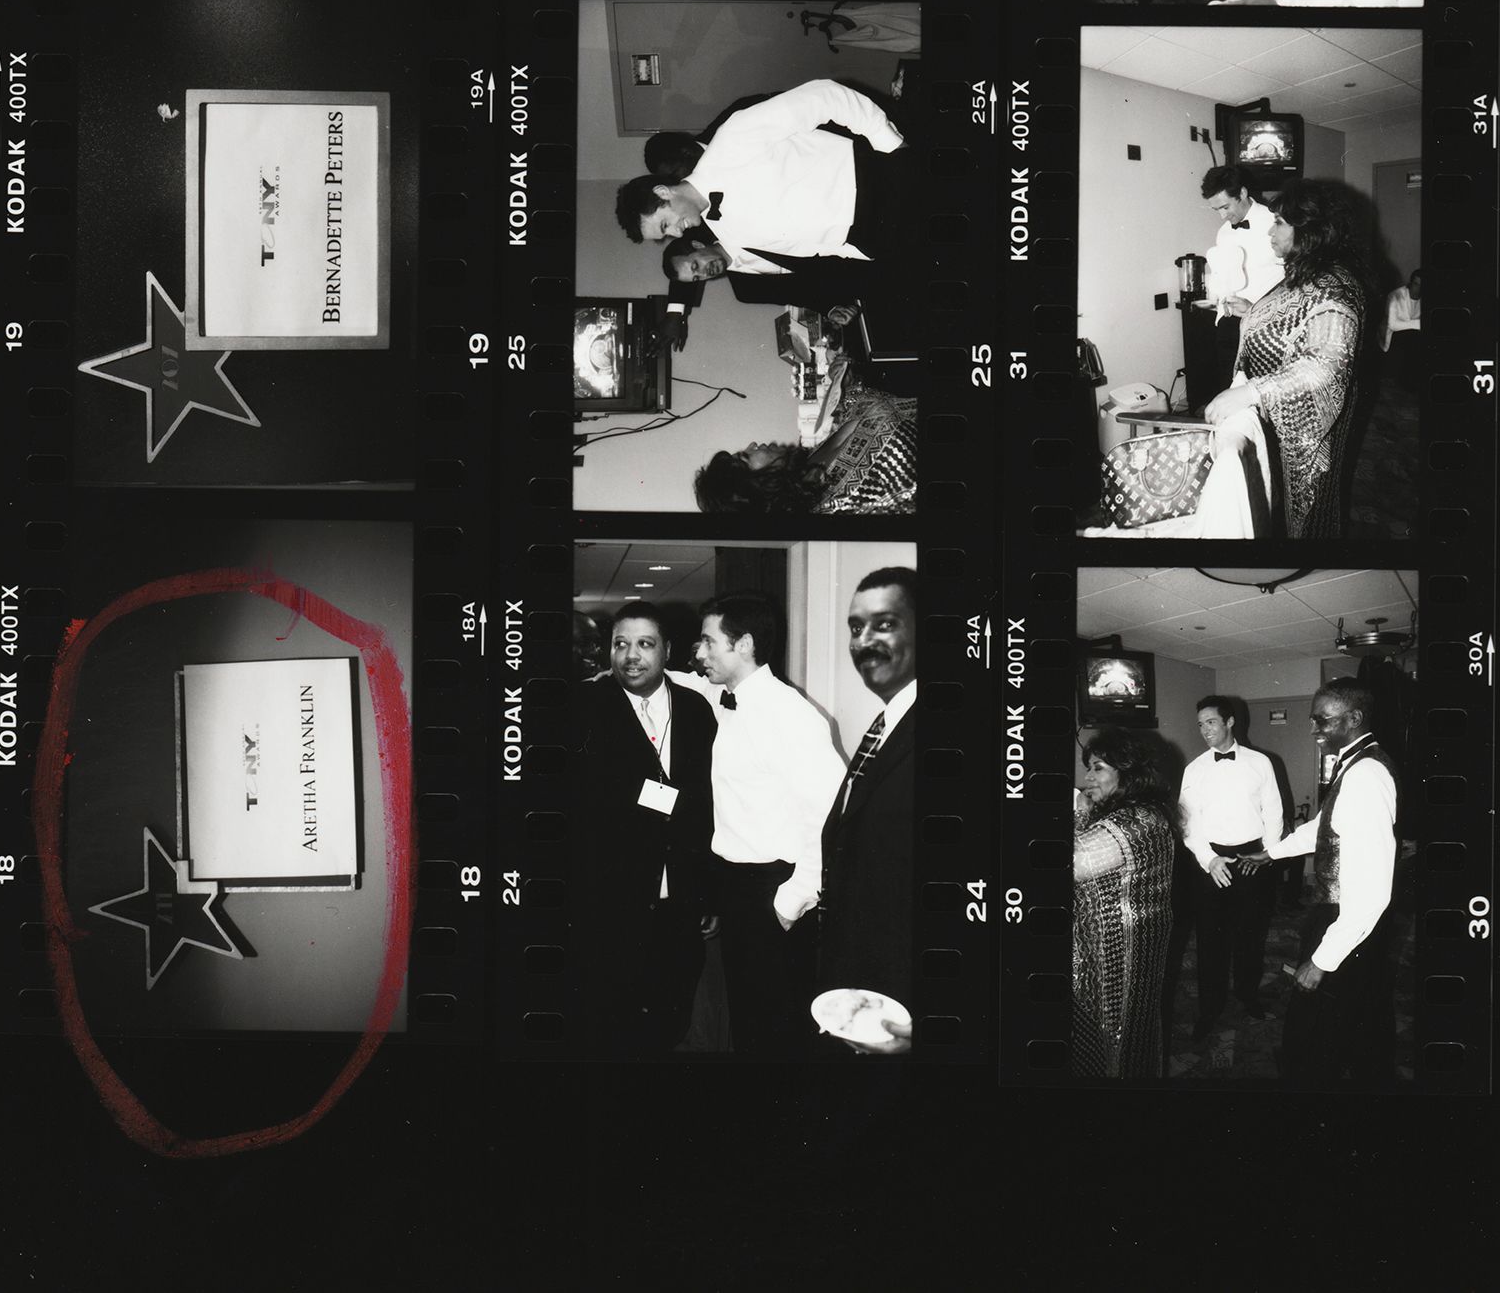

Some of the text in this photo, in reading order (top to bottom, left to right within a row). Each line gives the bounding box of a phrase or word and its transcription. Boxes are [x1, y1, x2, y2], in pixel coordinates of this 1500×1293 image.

[471, 70, 483, 108] 19A
[972, 81, 985, 123] 25A
[1474, 95, 1487, 134] 31A
[322, 111, 343, 324] BERNADETTE PETERS
[469, 334, 489, 369] 19
[508, 335, 525, 370] 25
[972, 345, 991, 387] 25
[1473, 361, 1494, 394] 31
[0, 586, 18, 765] KODAK 400TX
[504, 600, 523, 780] KODAK 400TX
[1006, 618, 1025, 798] KODAK 400TX
[299, 684, 318, 853] ARETHA FRANKLIN
[461, 866, 480, 901] 18
[503, 870, 520, 905] 24
[1005, 888, 1022, 923] 30
[1469, 896, 1489, 939] 30
